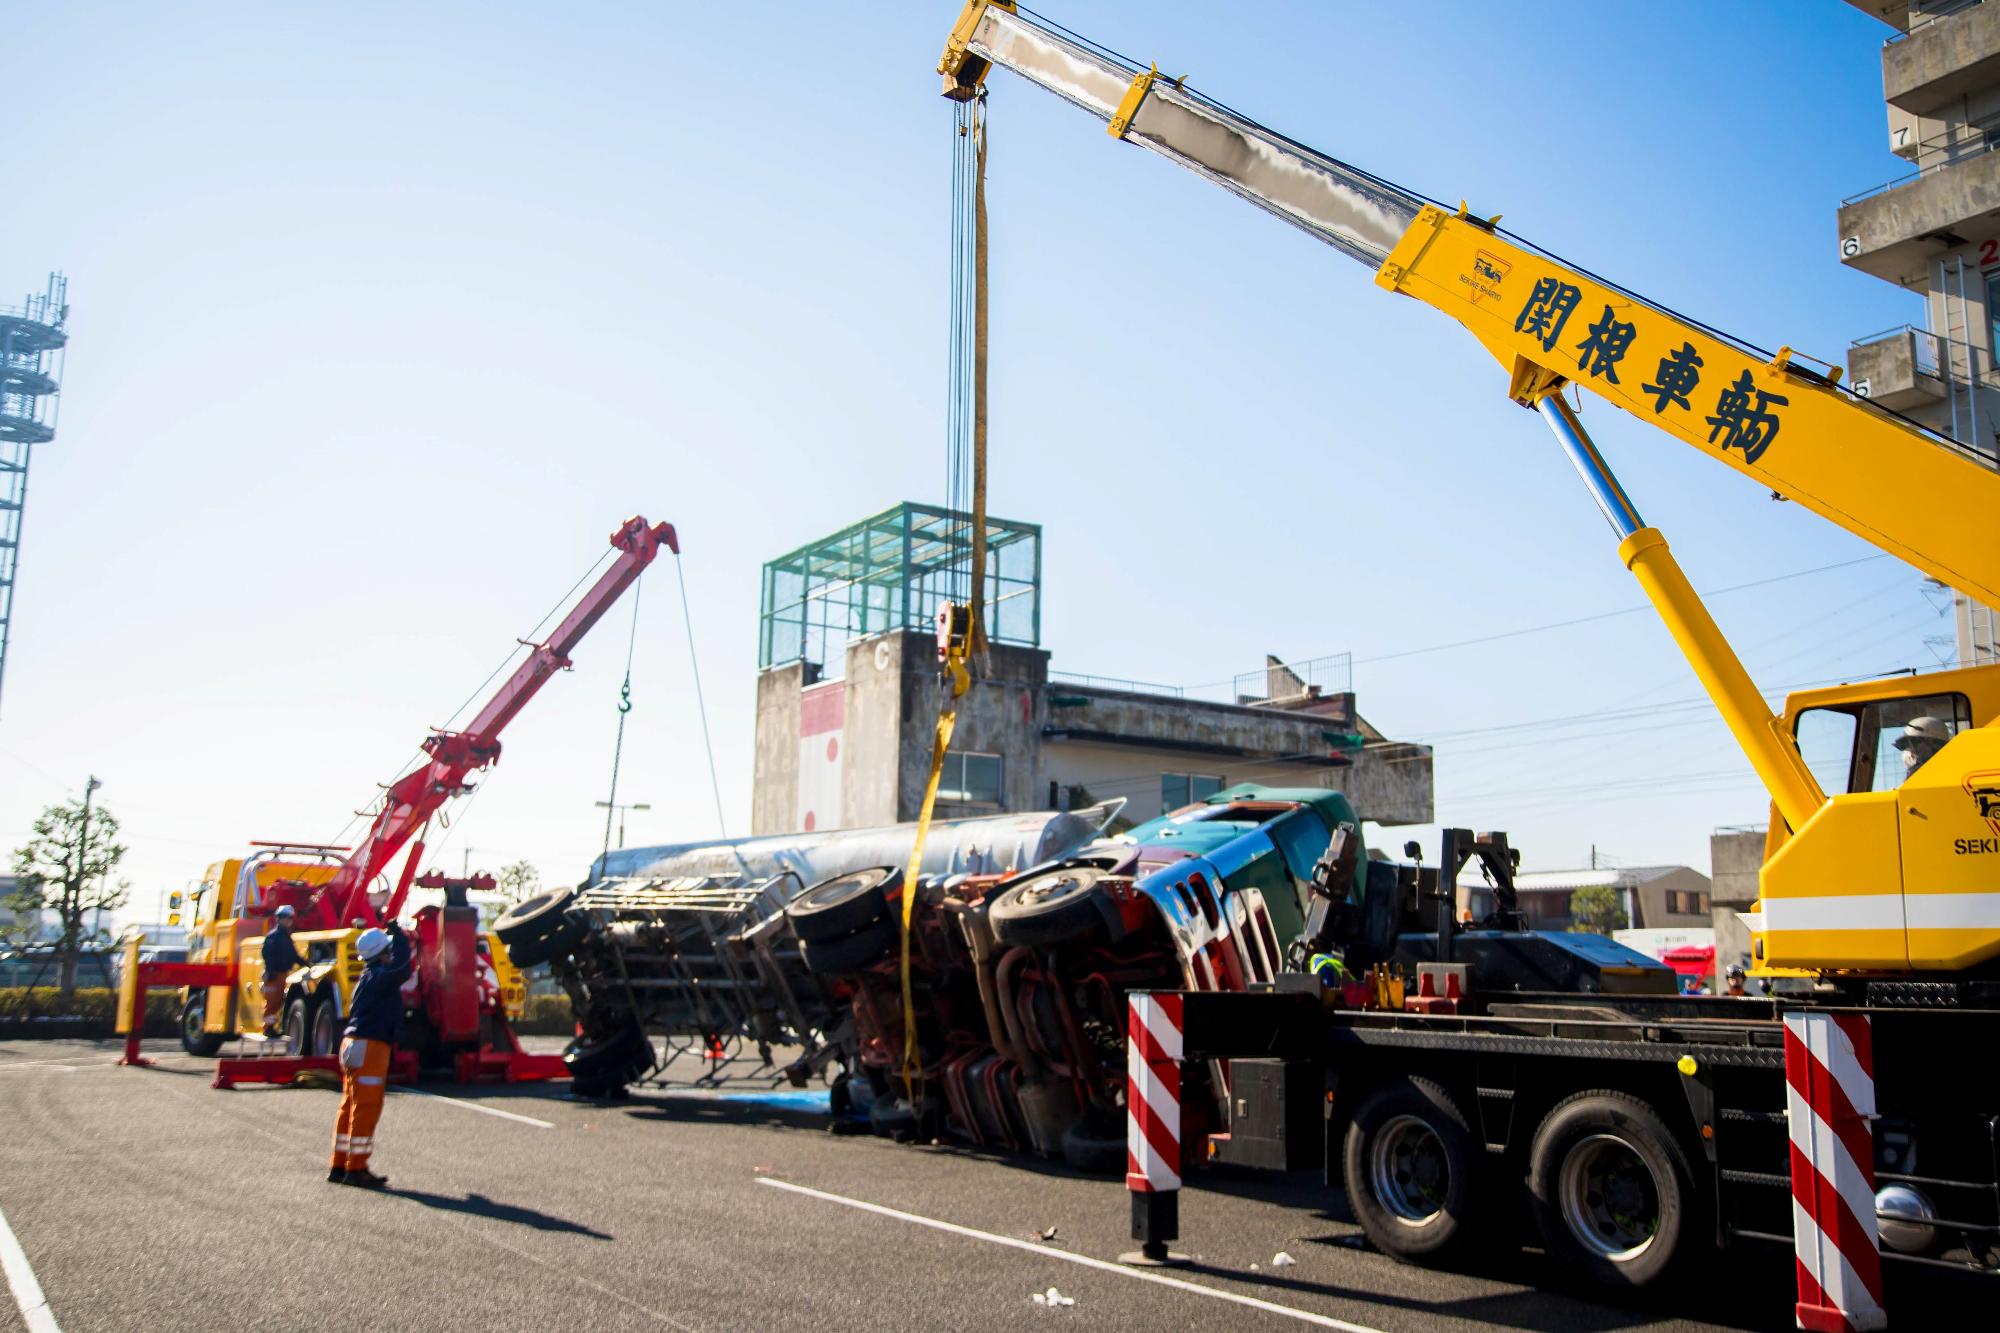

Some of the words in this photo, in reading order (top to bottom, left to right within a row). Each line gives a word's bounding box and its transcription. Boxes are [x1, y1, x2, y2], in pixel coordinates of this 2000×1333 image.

[1893, 127, 1909, 145] 7
[1843, 238, 1858, 256] 6
[1979, 239, 1999, 266] 2
[1854, 379, 1868, 396] 5
[875, 641, 889, 671] C
